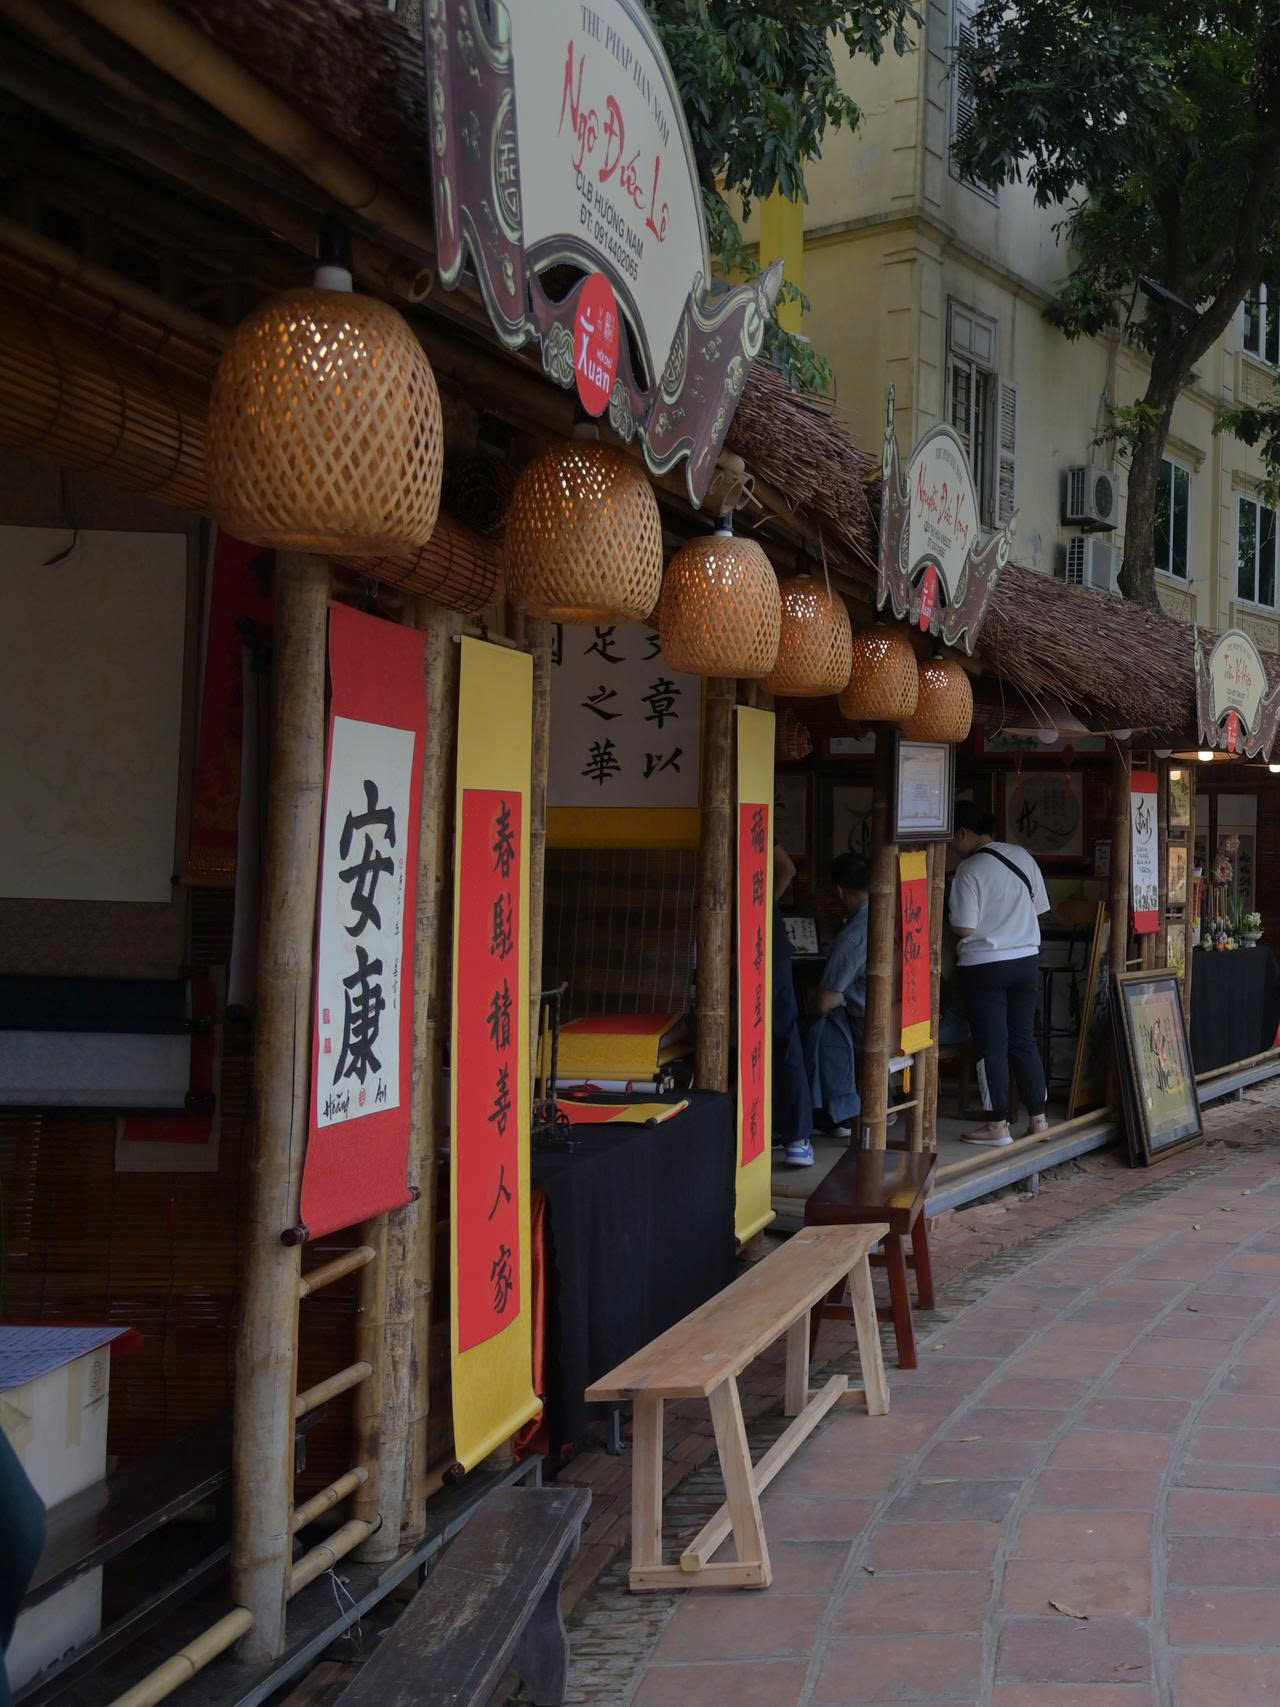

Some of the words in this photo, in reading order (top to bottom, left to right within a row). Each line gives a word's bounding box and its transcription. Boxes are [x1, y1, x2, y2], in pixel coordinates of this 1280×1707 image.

[558, 39, 599, 171] Ngô
[598, 94, 646, 211] Đức
[645, 154, 670, 243] Lê
[575, 169, 594, 203] CLB
[625, 225, 644, 261] NAM
[579, 203, 593, 233] ĐT:
[594, 221, 639, 281] 0914402065
[332, 779, 396, 1086] 安康
